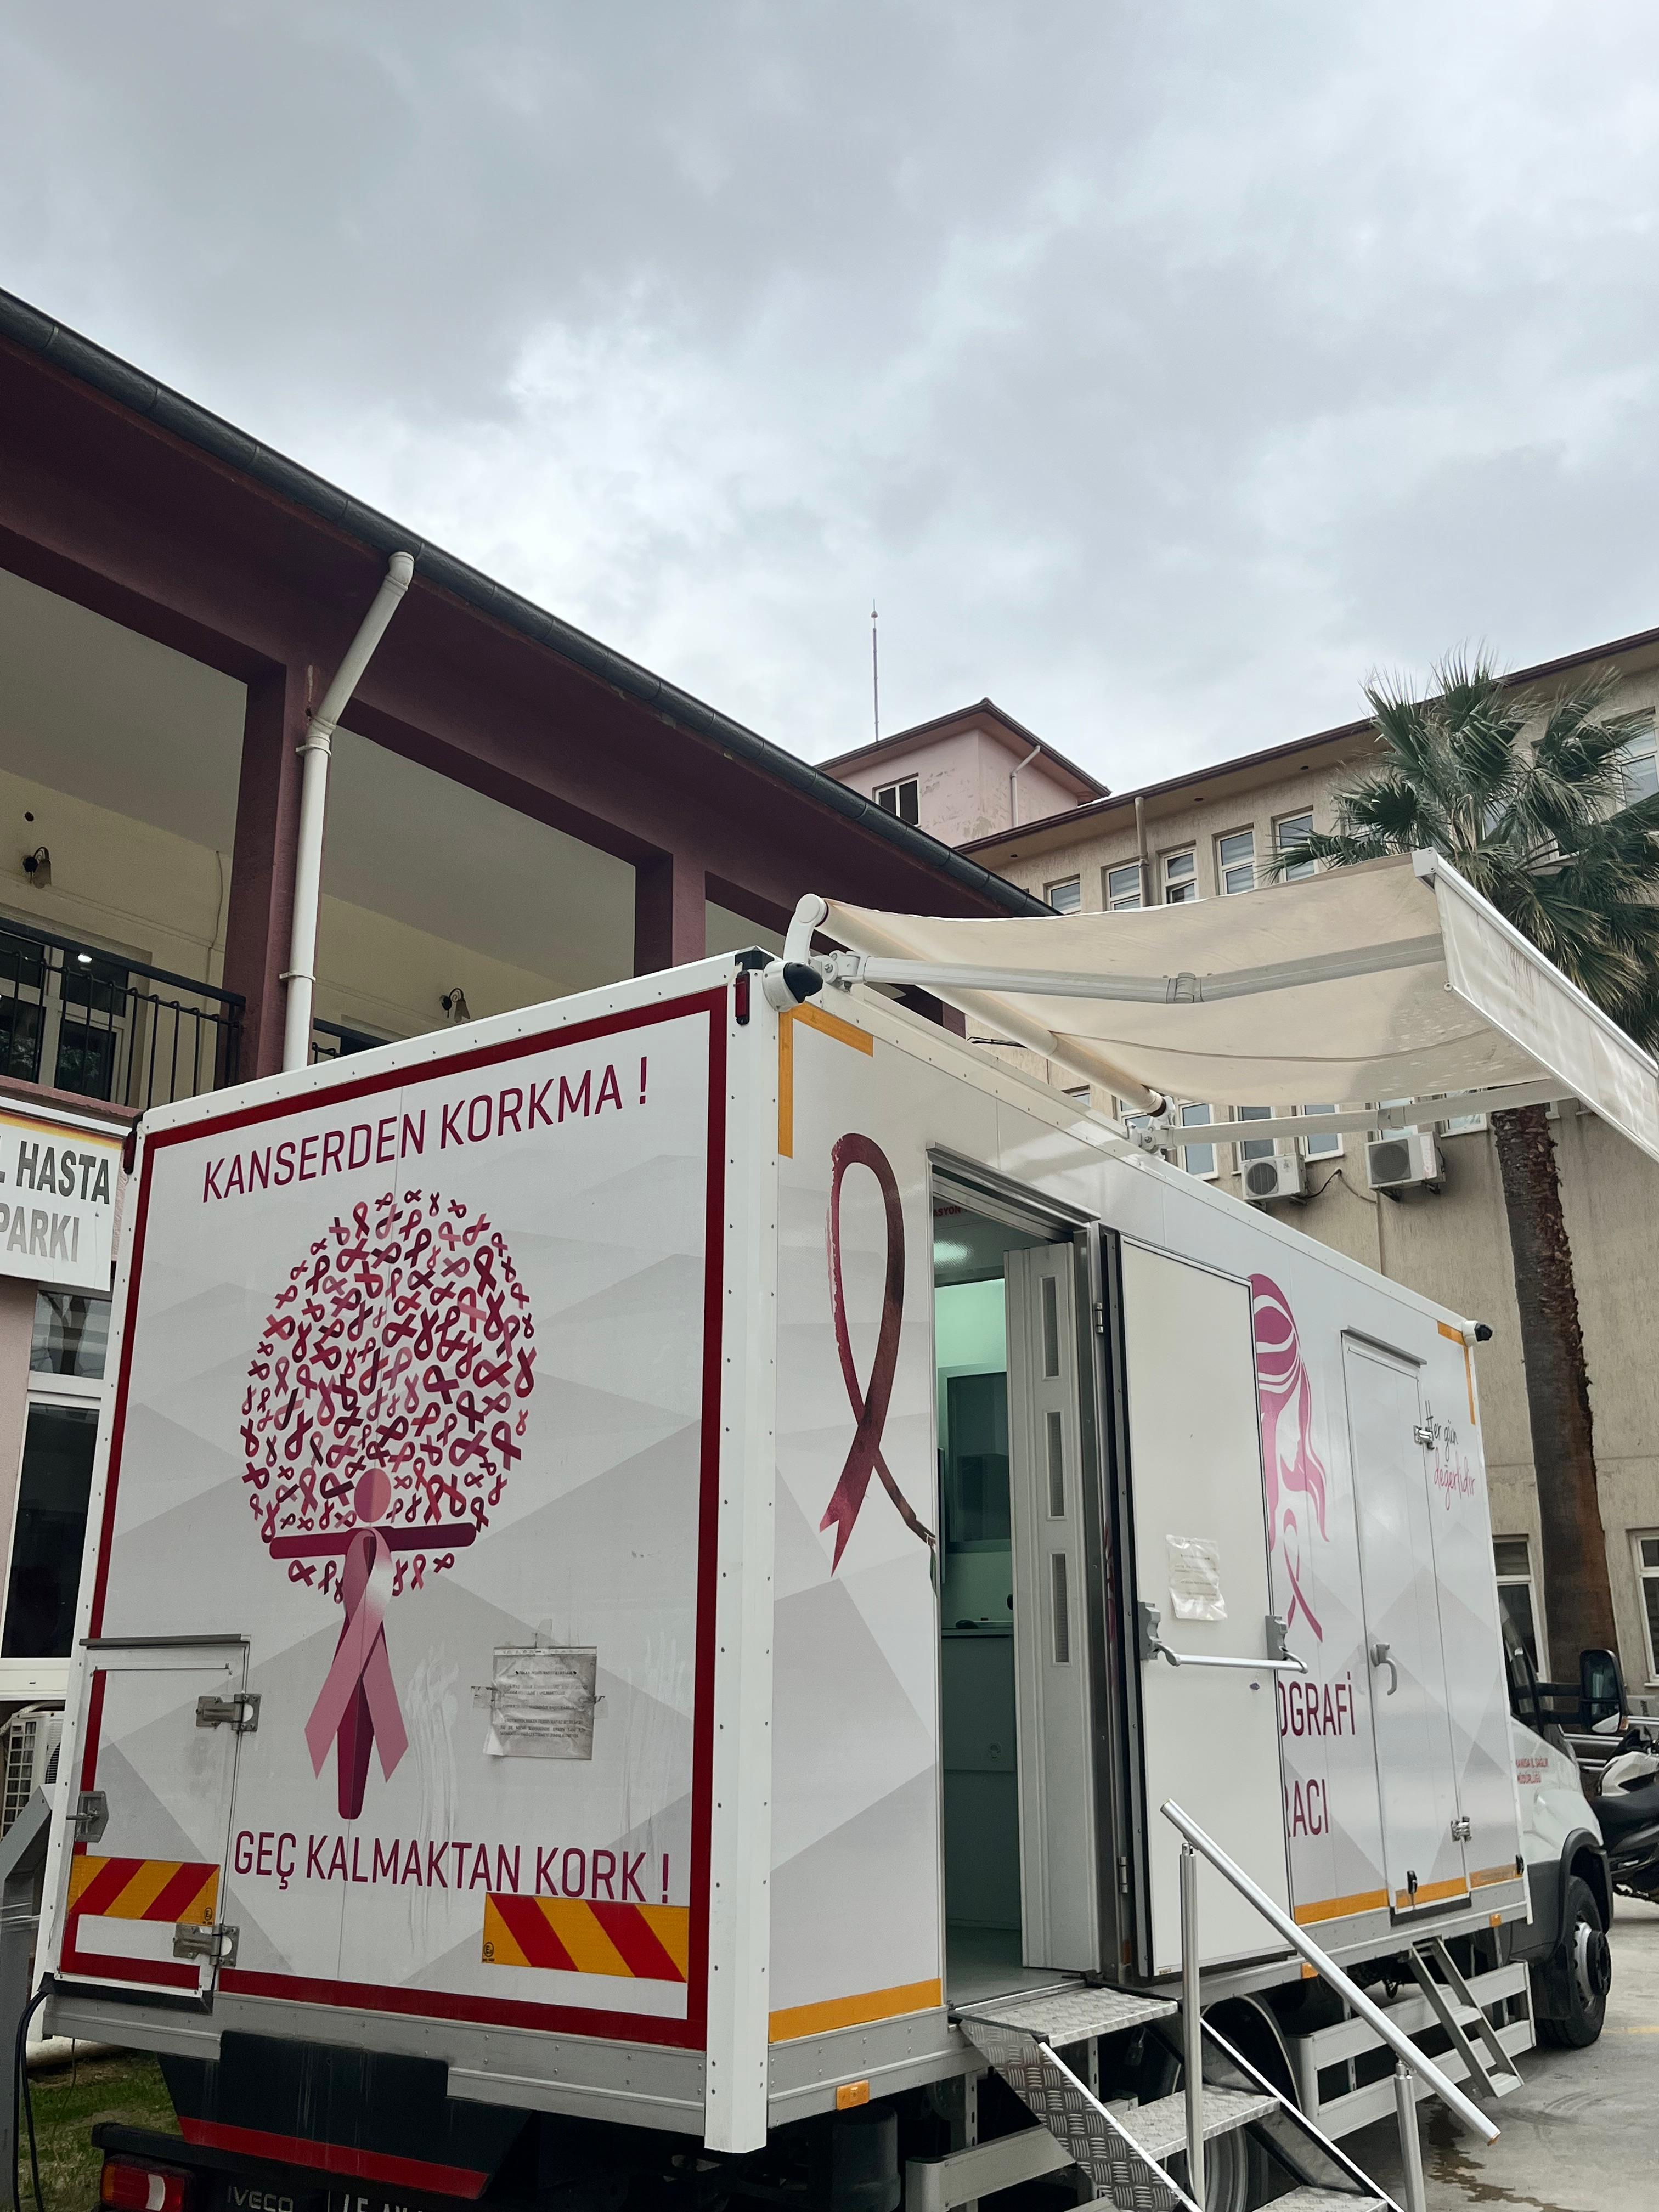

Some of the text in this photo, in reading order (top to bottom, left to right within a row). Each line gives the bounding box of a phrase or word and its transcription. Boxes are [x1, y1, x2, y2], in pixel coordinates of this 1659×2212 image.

[202, 1057, 647, 1203] KANSERDEN KORKMA !
[16, 1140, 110, 1204] HASTA
[1444, 1419, 1459, 1462] gün
[1434, 1447, 1475, 1510] değerlidir
[1285, 1779, 1328, 1837] ACI
[235, 1831, 669, 1904] GEÇ KALMAKTAN KORK !
[228, 2185, 293, 2212] IVECO
